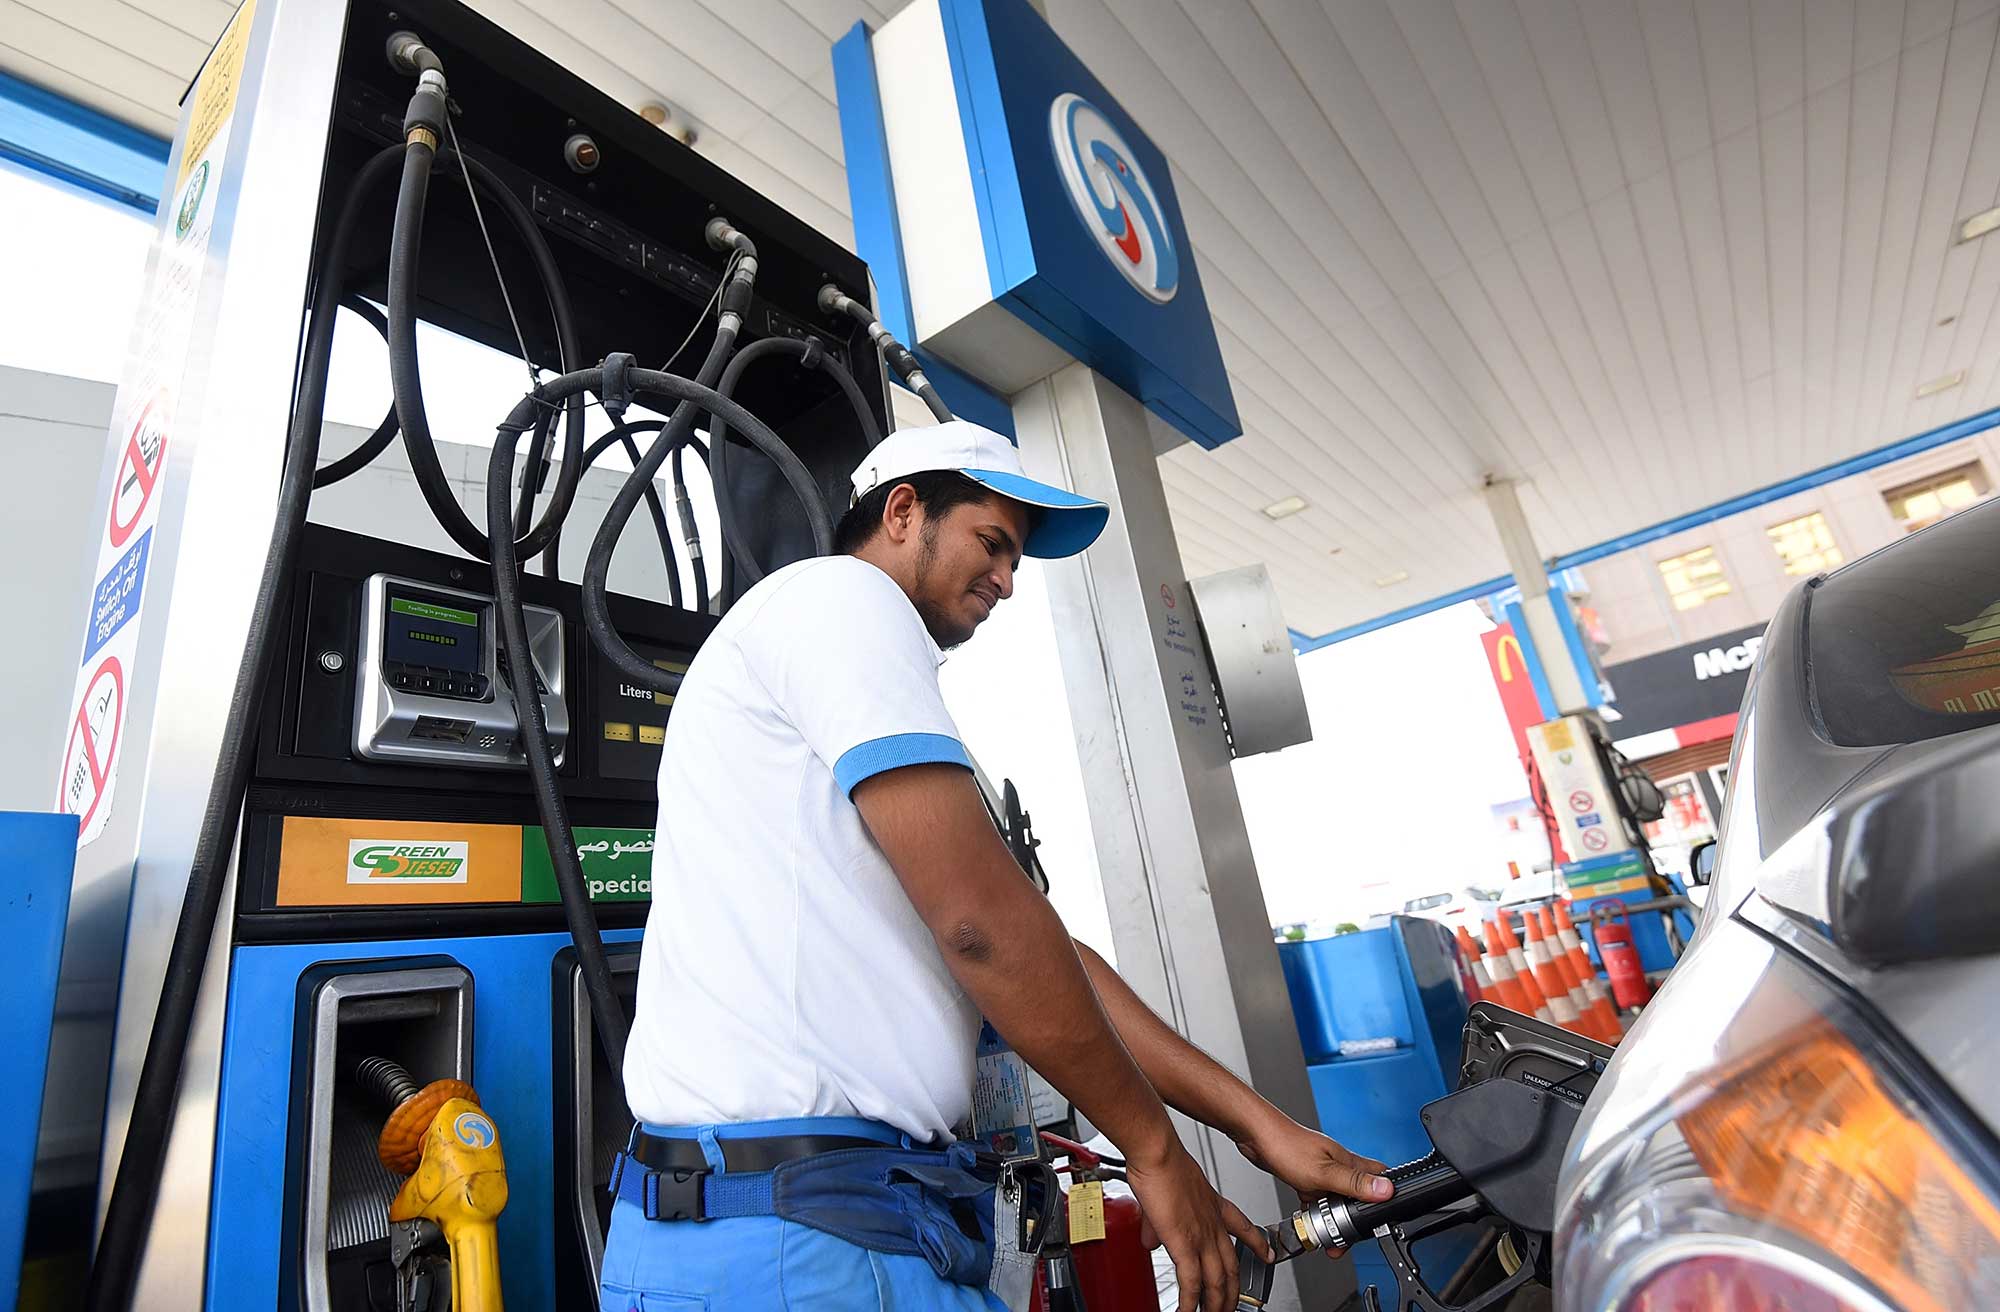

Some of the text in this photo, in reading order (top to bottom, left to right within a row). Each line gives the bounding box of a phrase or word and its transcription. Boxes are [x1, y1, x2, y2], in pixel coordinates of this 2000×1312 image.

[95, 568, 138, 627] Switch Off
[96, 603, 126, 644] Engine
[619, 683, 653, 700] Liters
[353, 846, 451, 869] GREEN
[368, 855, 459, 878] DIESEL
[584, 874, 652, 899] pecia
